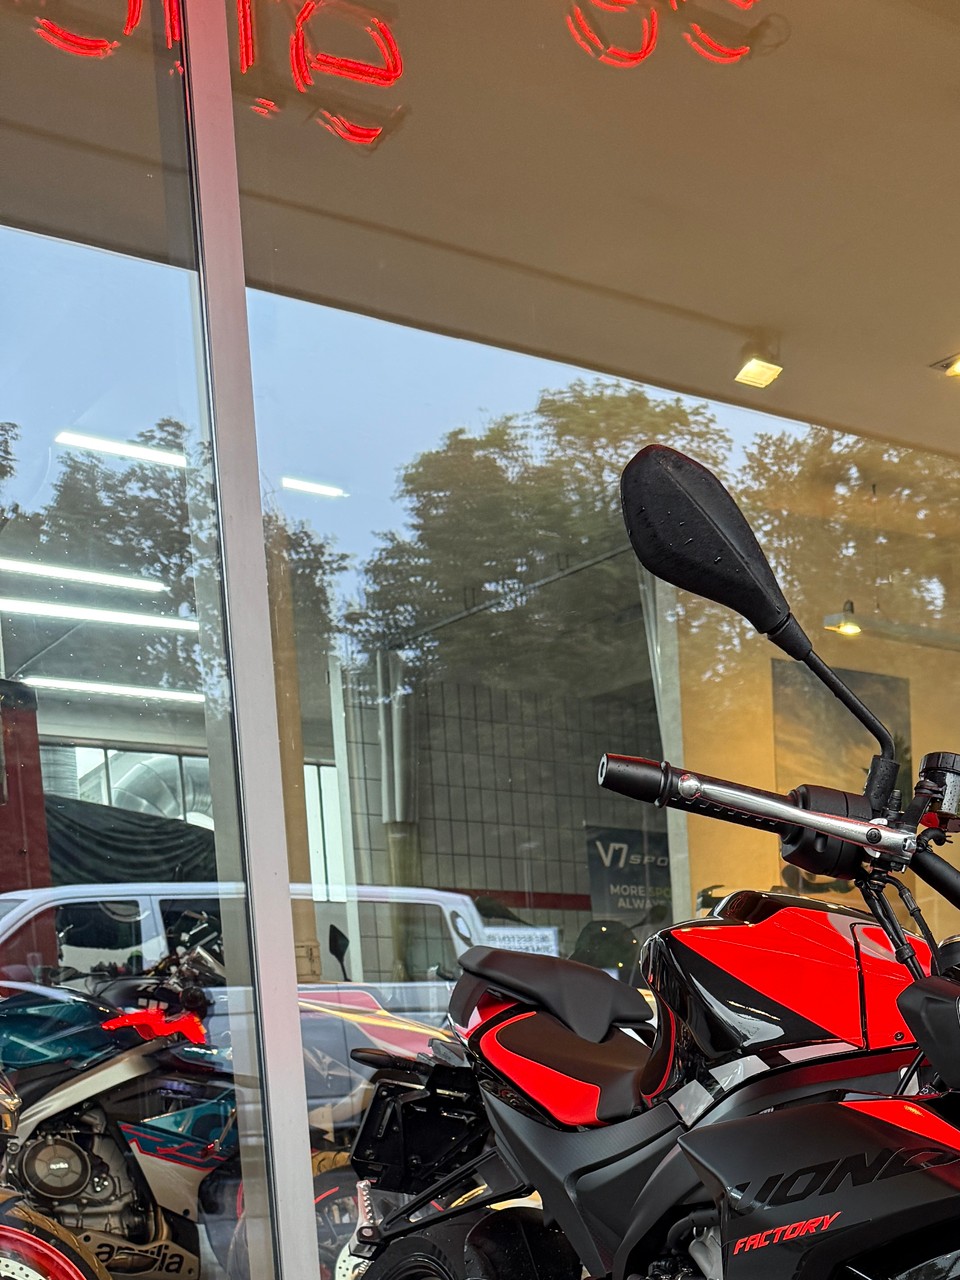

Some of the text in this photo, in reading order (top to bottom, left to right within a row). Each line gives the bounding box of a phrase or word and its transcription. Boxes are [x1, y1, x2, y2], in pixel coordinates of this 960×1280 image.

[595, 841, 628, 868] V7
[610, 884, 646, 897] MORE
[733, 1211, 843, 1256] FACTORY
